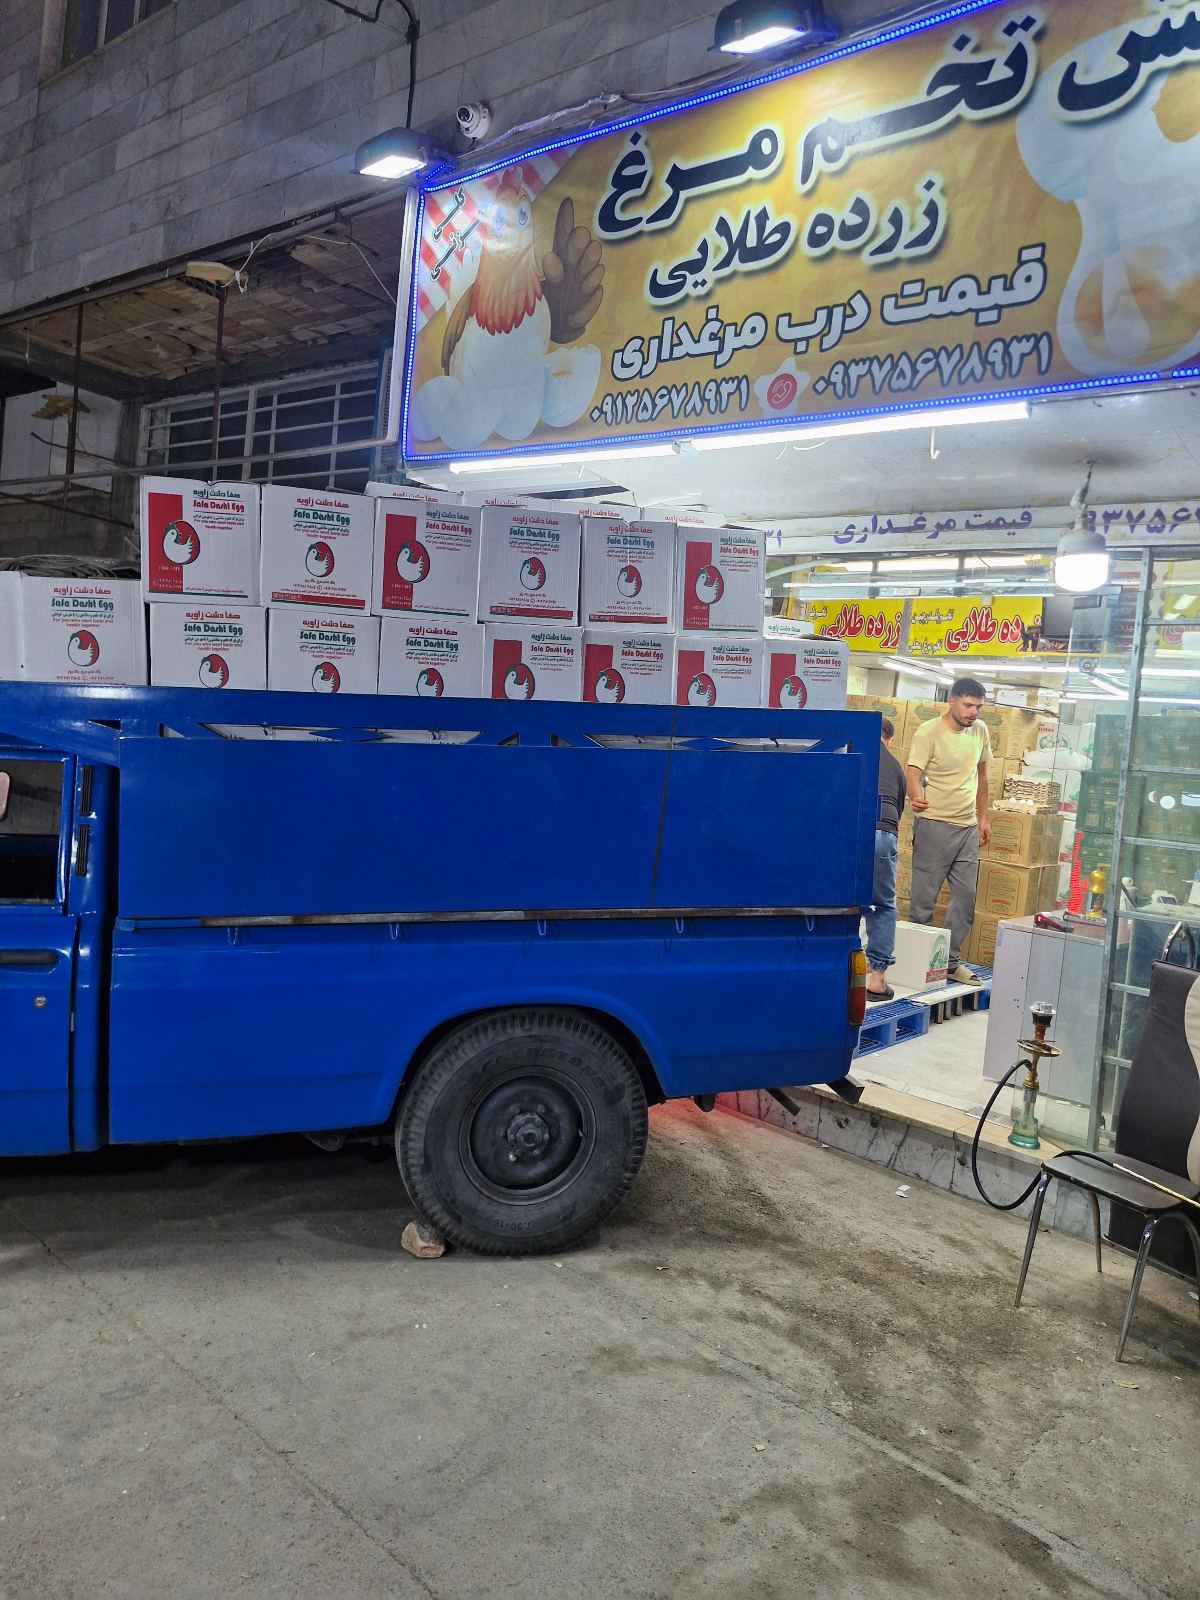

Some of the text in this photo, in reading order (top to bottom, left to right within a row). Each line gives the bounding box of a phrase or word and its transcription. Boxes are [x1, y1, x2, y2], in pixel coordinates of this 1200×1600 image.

[800, 15, 1036, 186] تخم
[598, 129, 777, 232] مرغ
[650, 179, 940, 296] زرده طلایی
[611, 242, 1047, 380] قیمت درب مرغداری
[811, 332, 1053, 400] ۰۹۳۷۵۶۷۸۹۳۱
[588, 375, 750, 426] ۰۹۱۲۵۶۷۸۹۳۱
[193, 489, 208, 498] زاویه
[210, 489, 225, 497] دشت
[193, 500, 244, 512] Safa Dasht Egg
[294, 510, 350, 526] Safa Dasht Egg
[833, 505, 1032, 544] قیمت مرغداری
[426, 521, 472, 535] Safa Dasht Egg
[509, 528, 560, 541] Safa Dasht Egg
[54, 586, 111, 595] صفا دشت زاویه
[52, 598, 114, 611] Safa Dasht Egg
[186, 611, 203, 620] زاویه
[184, 624, 243, 636] Safa Dasht Egg
[303, 619, 319, 628] زاویه
[945, 607, 997, 652] طلایی
[300, 631, 356, 645] Safa Dasht Egg
[406, 638, 458, 651] Safa Dasht Egg
[564, 647, 574, 655] Egg
